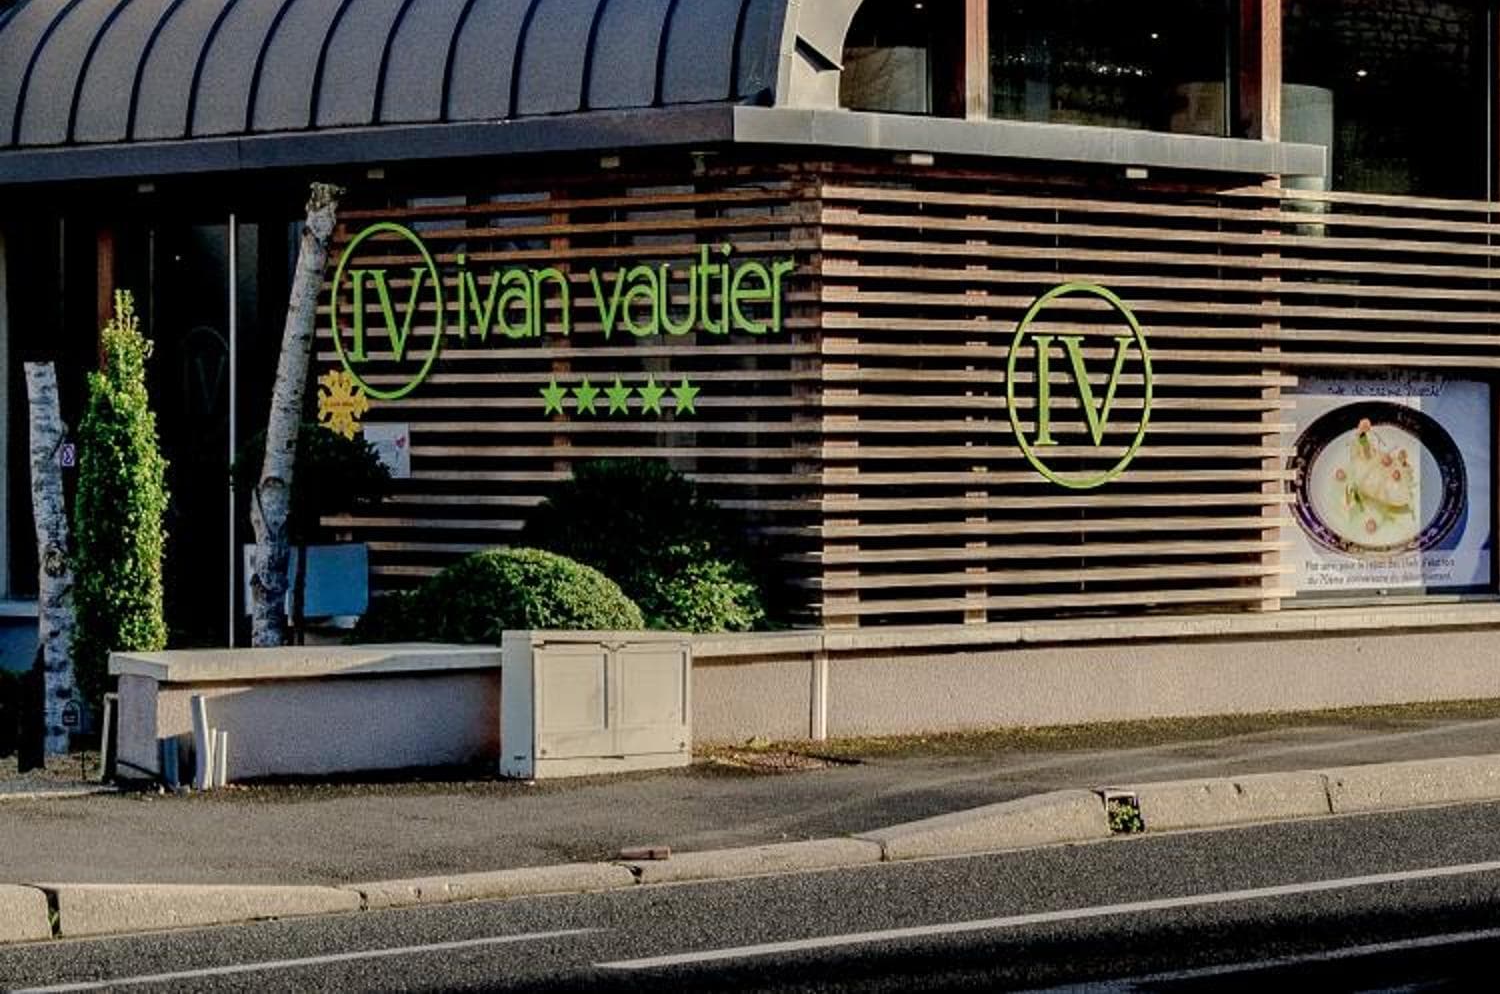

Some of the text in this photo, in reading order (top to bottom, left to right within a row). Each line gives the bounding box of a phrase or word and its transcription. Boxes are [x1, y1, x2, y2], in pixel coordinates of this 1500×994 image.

[348, 241, 795, 362] IV ivan vautier
[1031, 335, 1136, 447] IV
